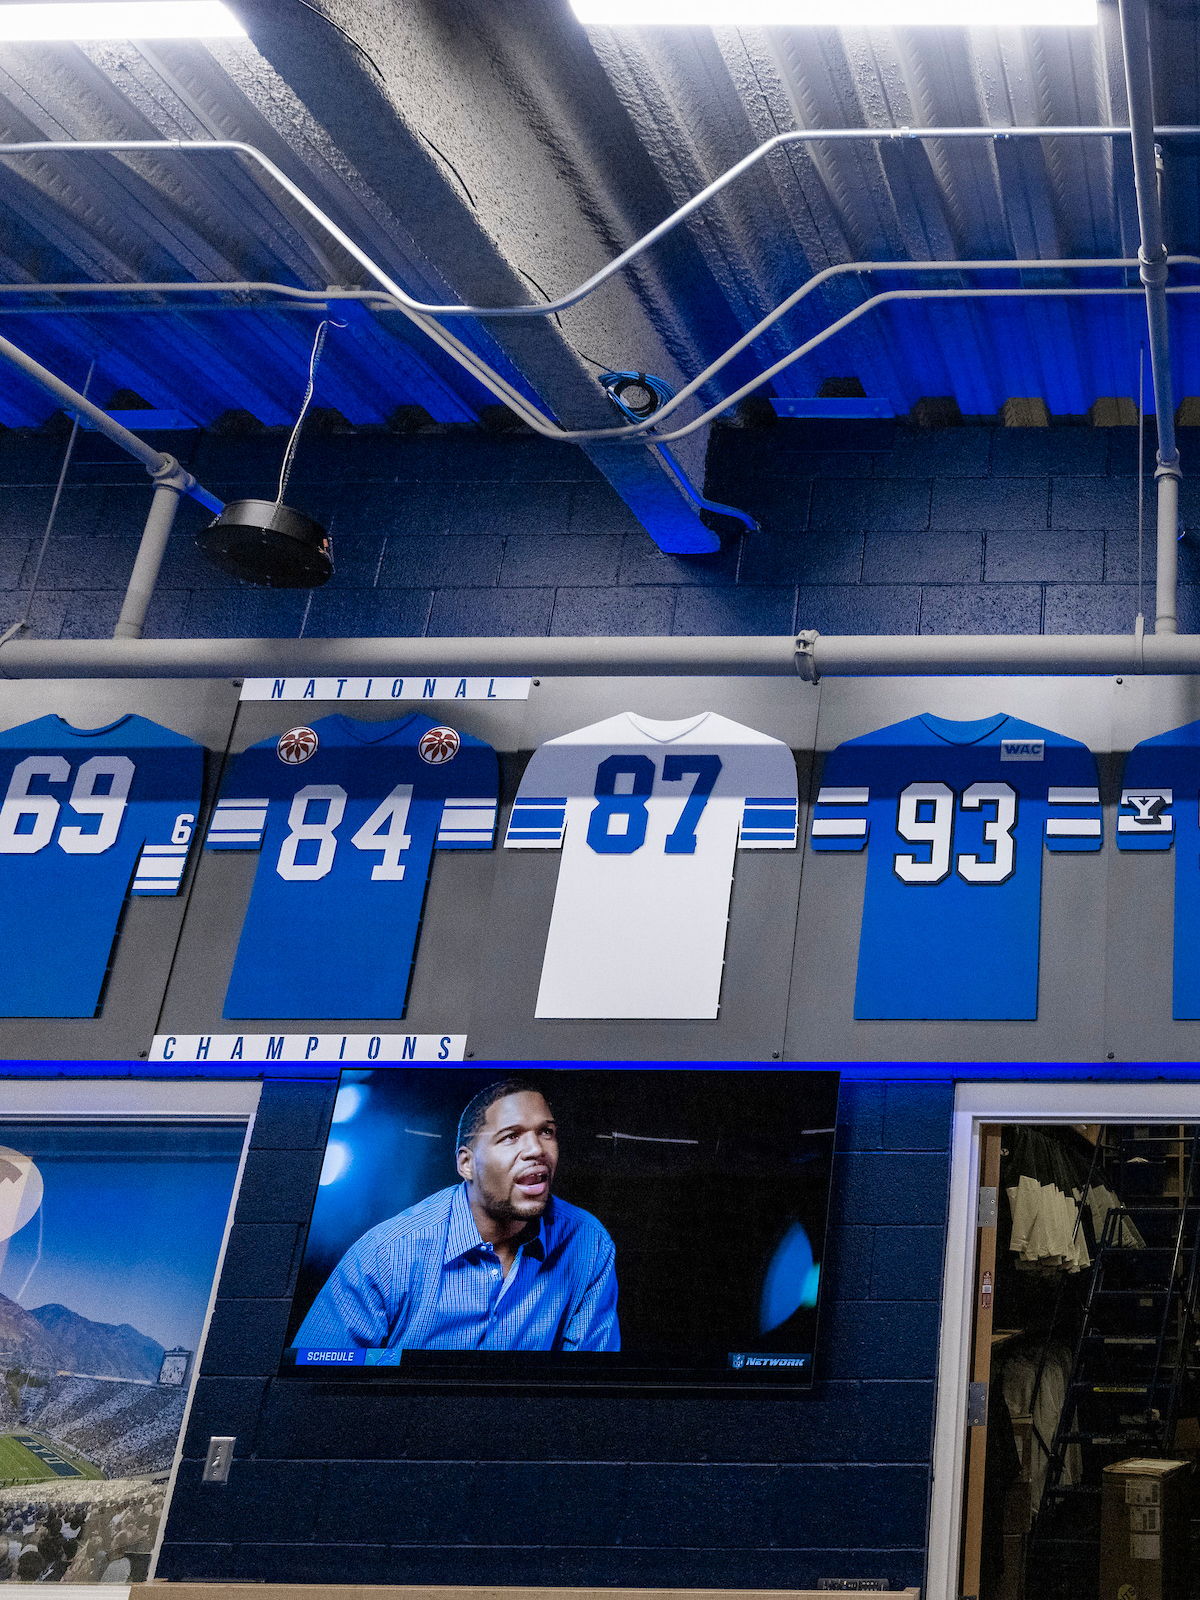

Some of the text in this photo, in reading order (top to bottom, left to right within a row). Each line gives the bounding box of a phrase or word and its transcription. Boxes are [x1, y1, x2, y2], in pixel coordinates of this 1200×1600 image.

[271, 679, 499, 699] NATIONAL
[1004, 744, 1042, 755] WAC
[0, 755, 136, 854] 69
[586, 755, 723, 854] 87
[1128, 796, 1163, 822] Y
[172, 813, 195, 844] 6
[276, 784, 415, 881] 84
[893, 780, 1019, 885] 93
[162, 1036, 452, 1060] CHAMPIONS
[307, 1351, 354, 1362] SCHEDULE
[745, 1357, 805, 1367] NETWORK
